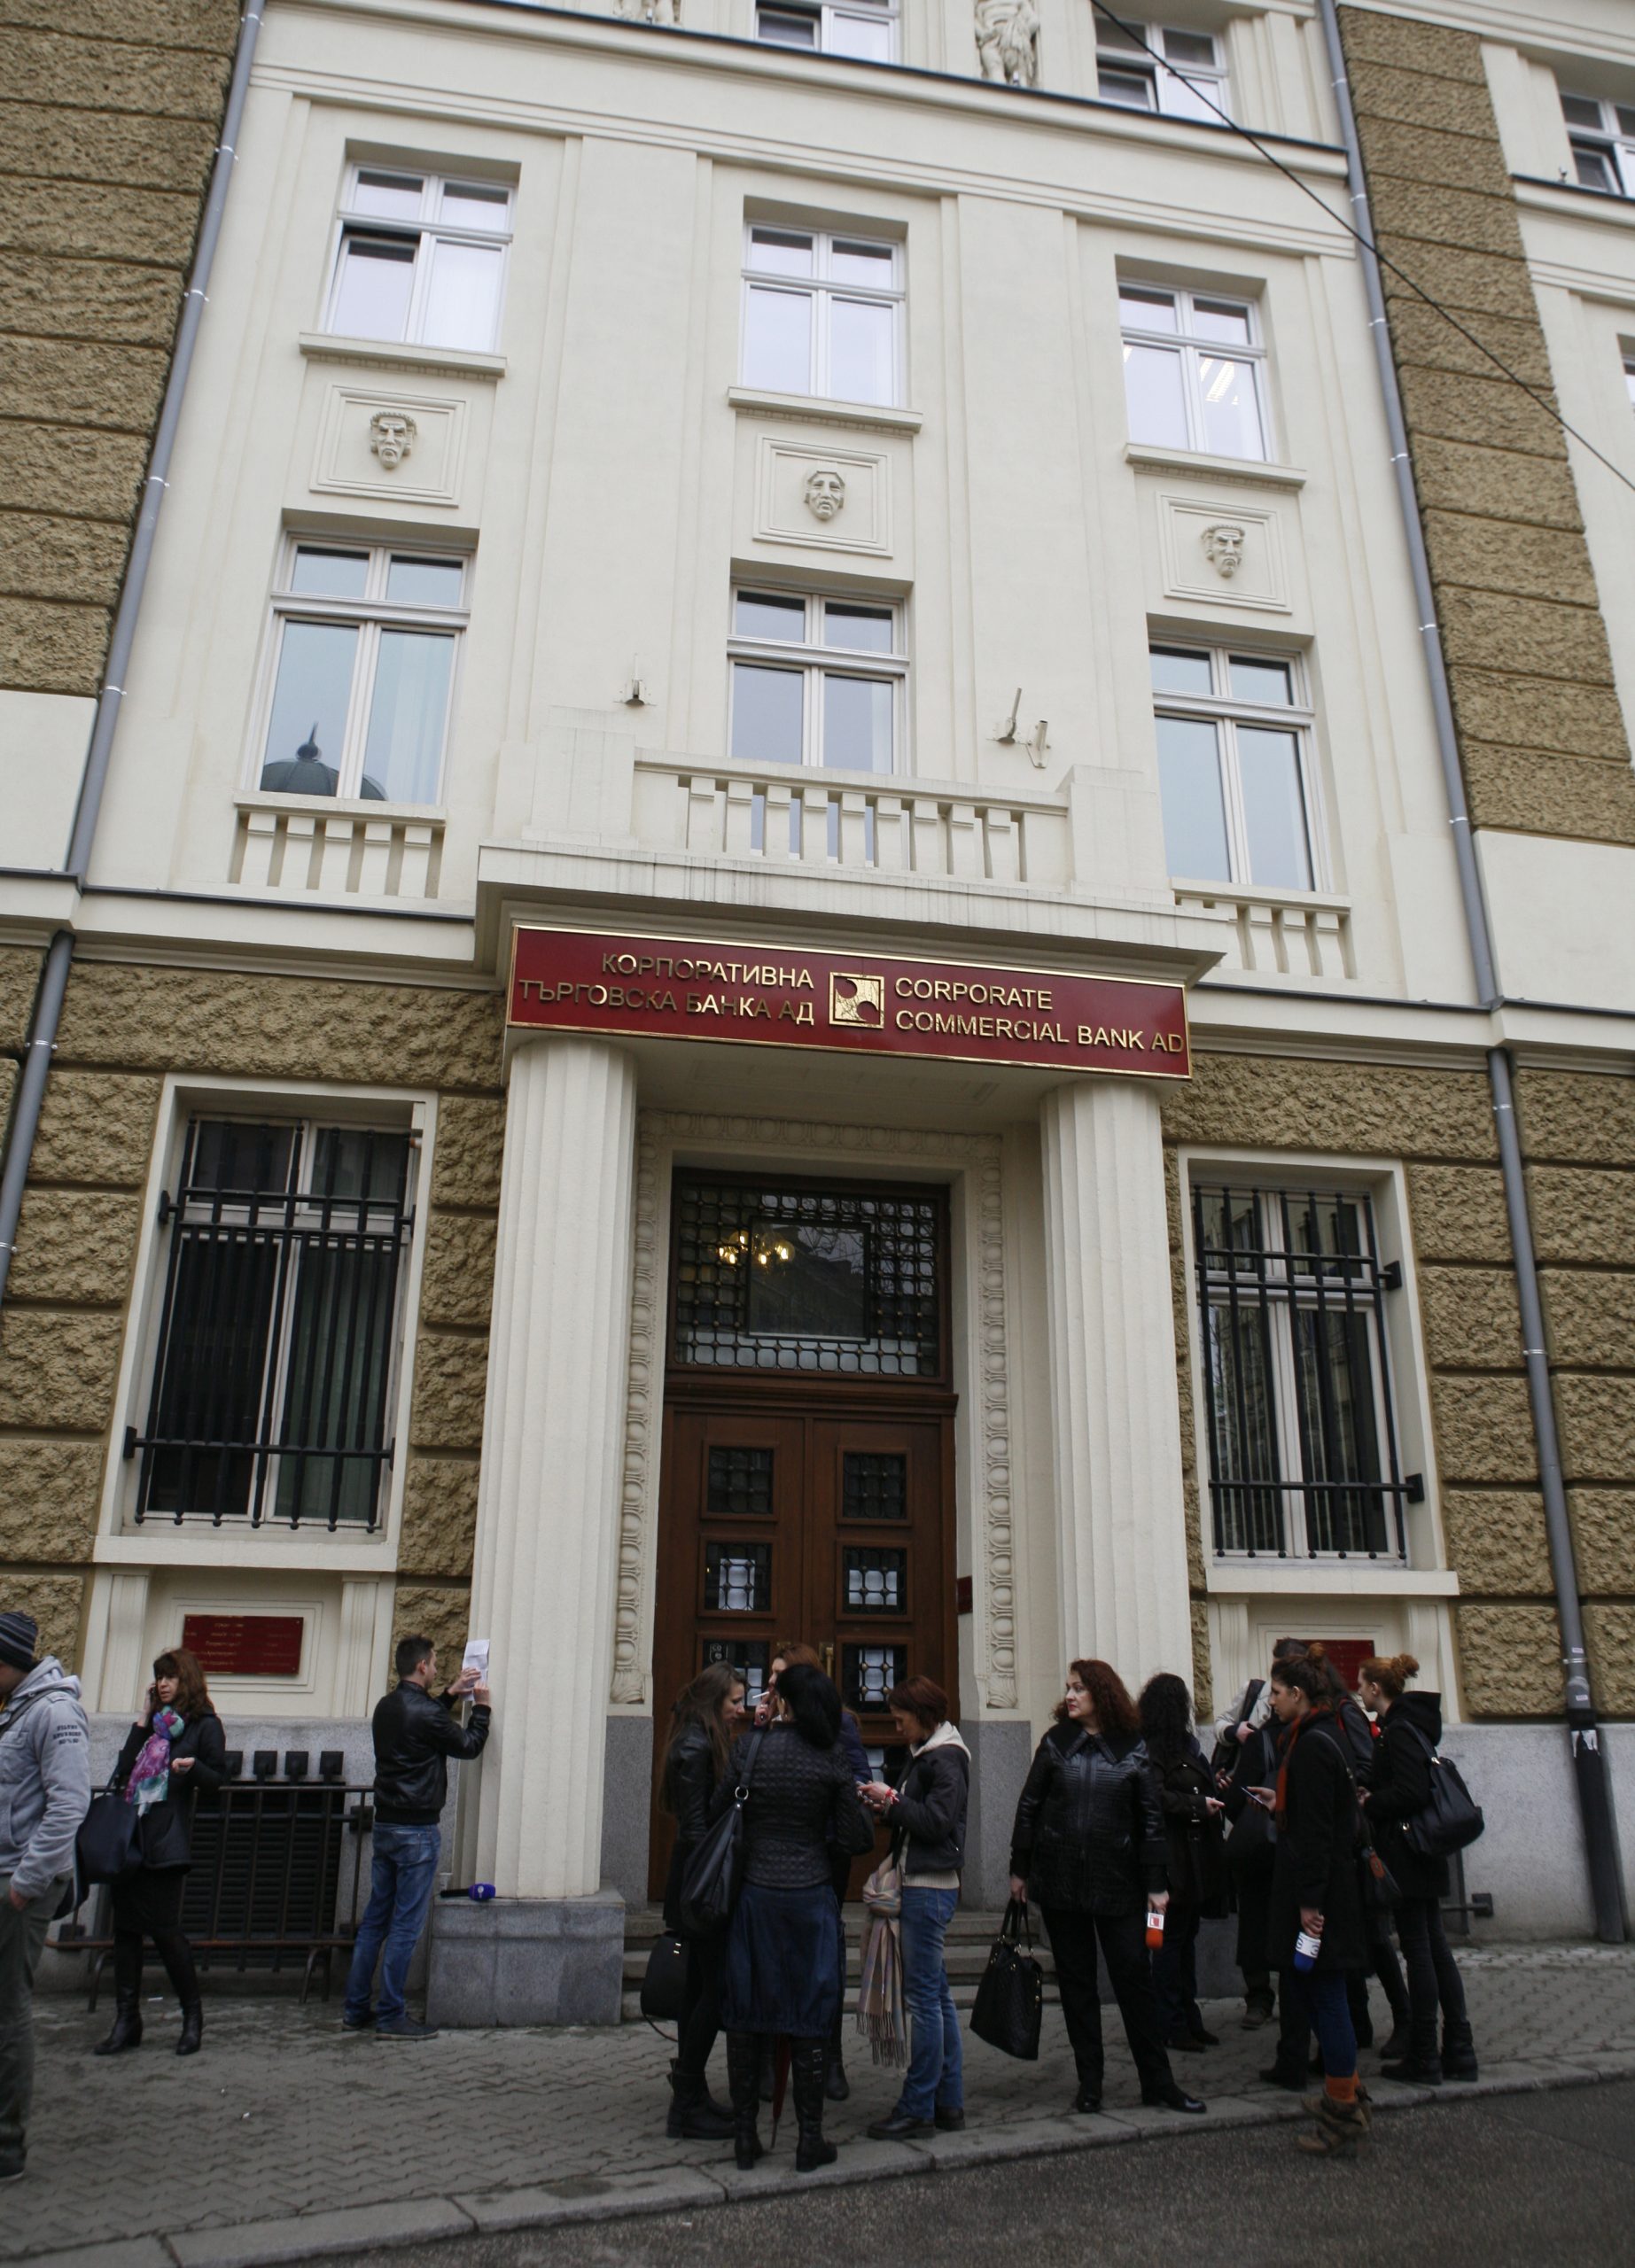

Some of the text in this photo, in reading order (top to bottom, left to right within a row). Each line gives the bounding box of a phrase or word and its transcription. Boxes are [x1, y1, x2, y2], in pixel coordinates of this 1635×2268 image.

[602, 952, 814, 989] КОРПОРАТИВНА
[518, 979, 814, 1026] ТЪРГОВСКА БАНКА АД
[895, 977, 1053, 1011] CORPORATE
[895, 1010, 1184, 1054] COMMERCIAL BANK AD
